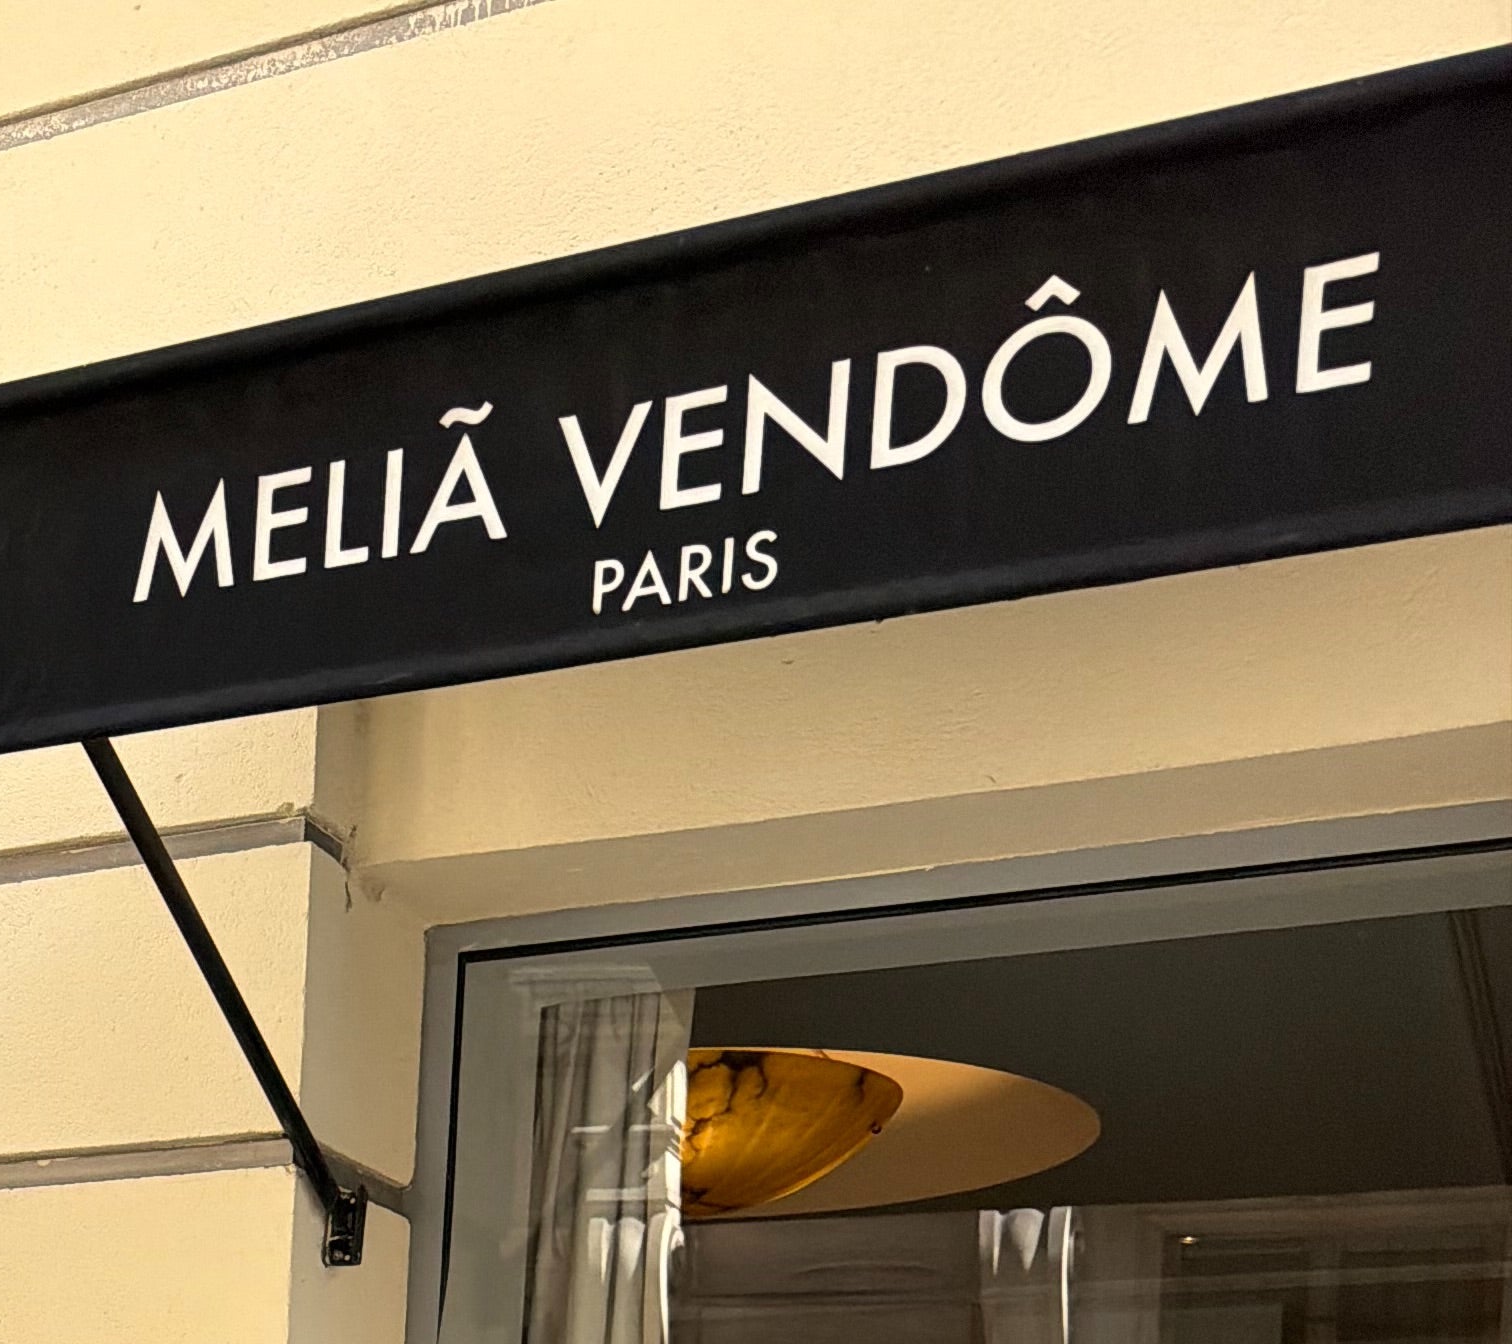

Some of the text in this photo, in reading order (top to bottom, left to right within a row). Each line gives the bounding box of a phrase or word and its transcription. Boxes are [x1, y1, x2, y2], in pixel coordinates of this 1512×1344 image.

[132, 251, 1380, 603] MELIÃ VENDÔME
[592, 529, 779, 614] PARIS
